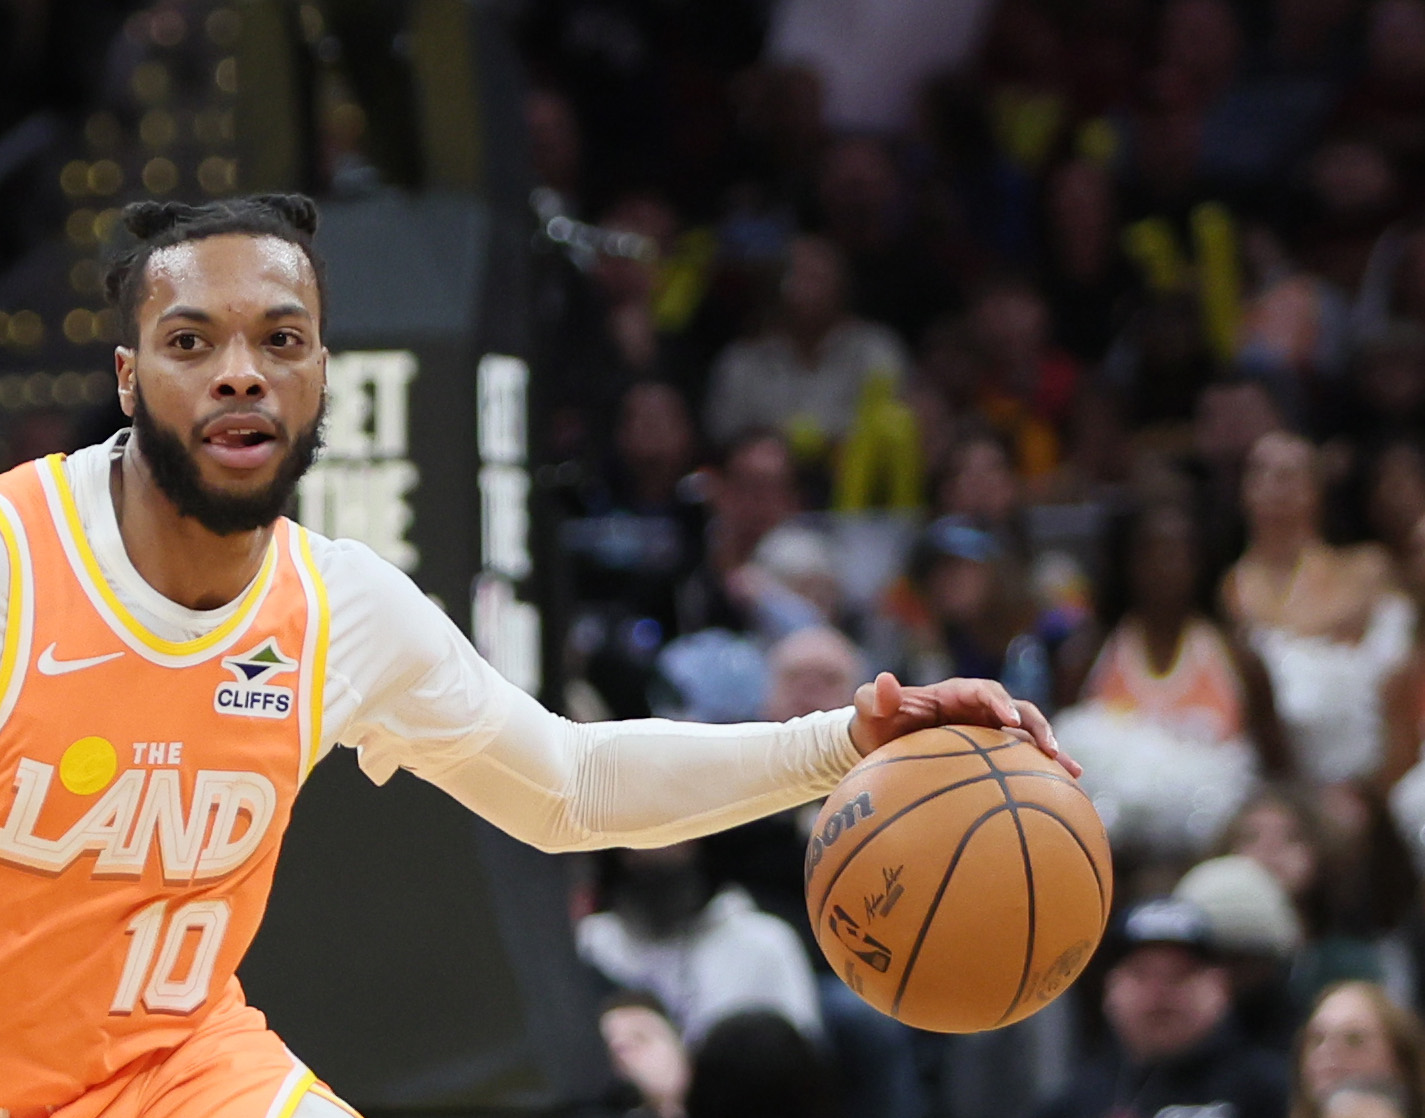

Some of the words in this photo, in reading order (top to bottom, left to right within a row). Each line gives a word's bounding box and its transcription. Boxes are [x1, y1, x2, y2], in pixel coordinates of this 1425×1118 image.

[217, 688, 290, 712] CLIFFS
[132, 742, 184, 765] THE
[109, 898, 232, 1017] 10
